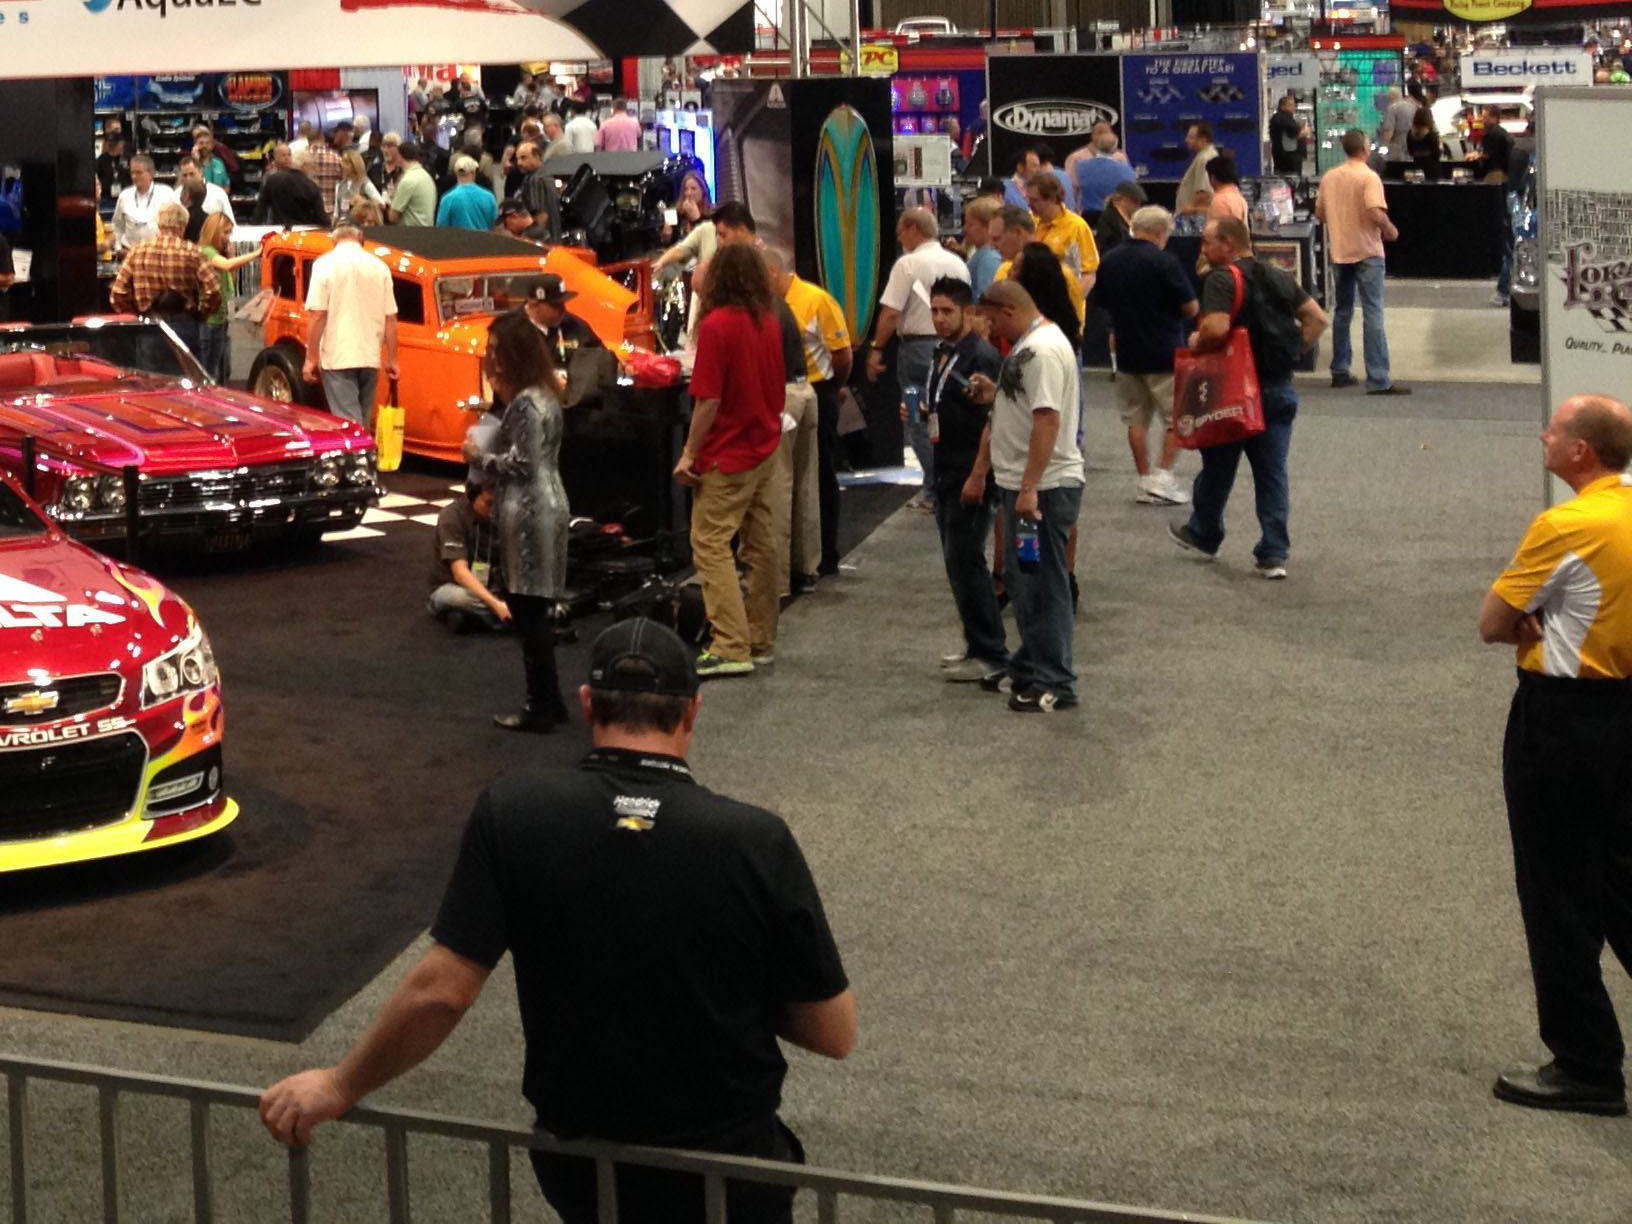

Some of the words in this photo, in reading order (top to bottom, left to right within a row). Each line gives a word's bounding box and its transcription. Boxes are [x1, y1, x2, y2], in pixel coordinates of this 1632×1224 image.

[1473, 61, 1577, 76] Beckett
[1013, 104, 1098, 133] Dynamat
[97, 716, 128, 733] SS
[613, 795, 662, 808] Hendrick
